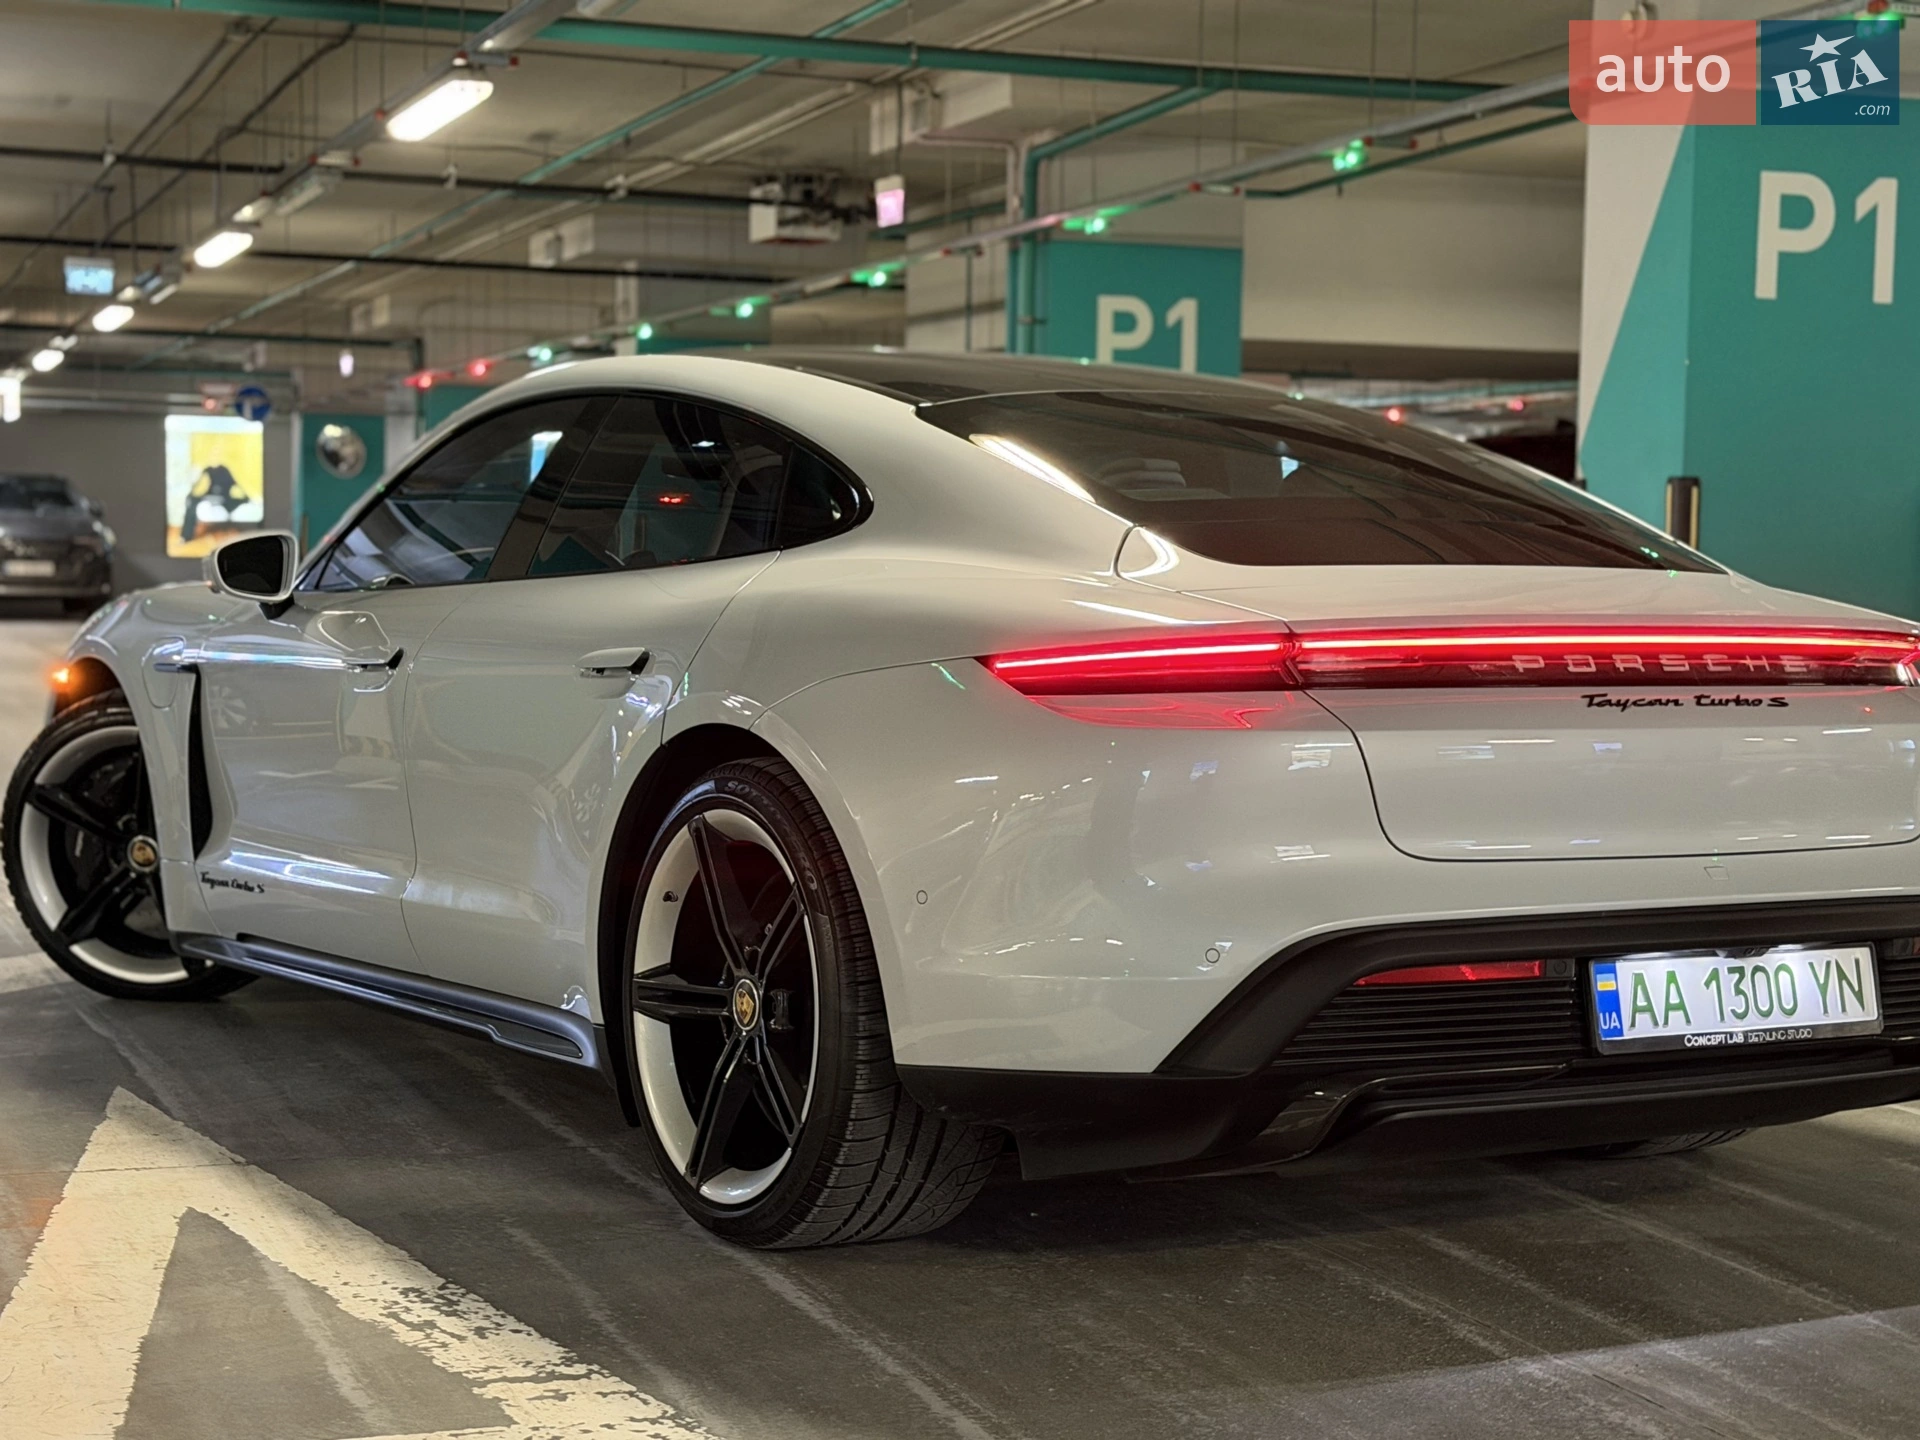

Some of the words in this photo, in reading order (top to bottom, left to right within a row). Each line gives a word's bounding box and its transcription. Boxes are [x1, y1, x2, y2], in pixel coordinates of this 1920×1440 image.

[1755, 170, 1898, 304] P1
[1096, 294, 1198, 374] P1
[1512, 654, 1808, 673] PORSCHE
[1581, 694, 1683, 712] Taycan
[1629, 970, 1692, 1030] AA
[1703, 963, 1798, 1023] 1300
[1808, 957, 1866, 1017] YN
[1600, 1011, 1621, 1029] UA
[1727, 1033, 1744, 1044] LAB
